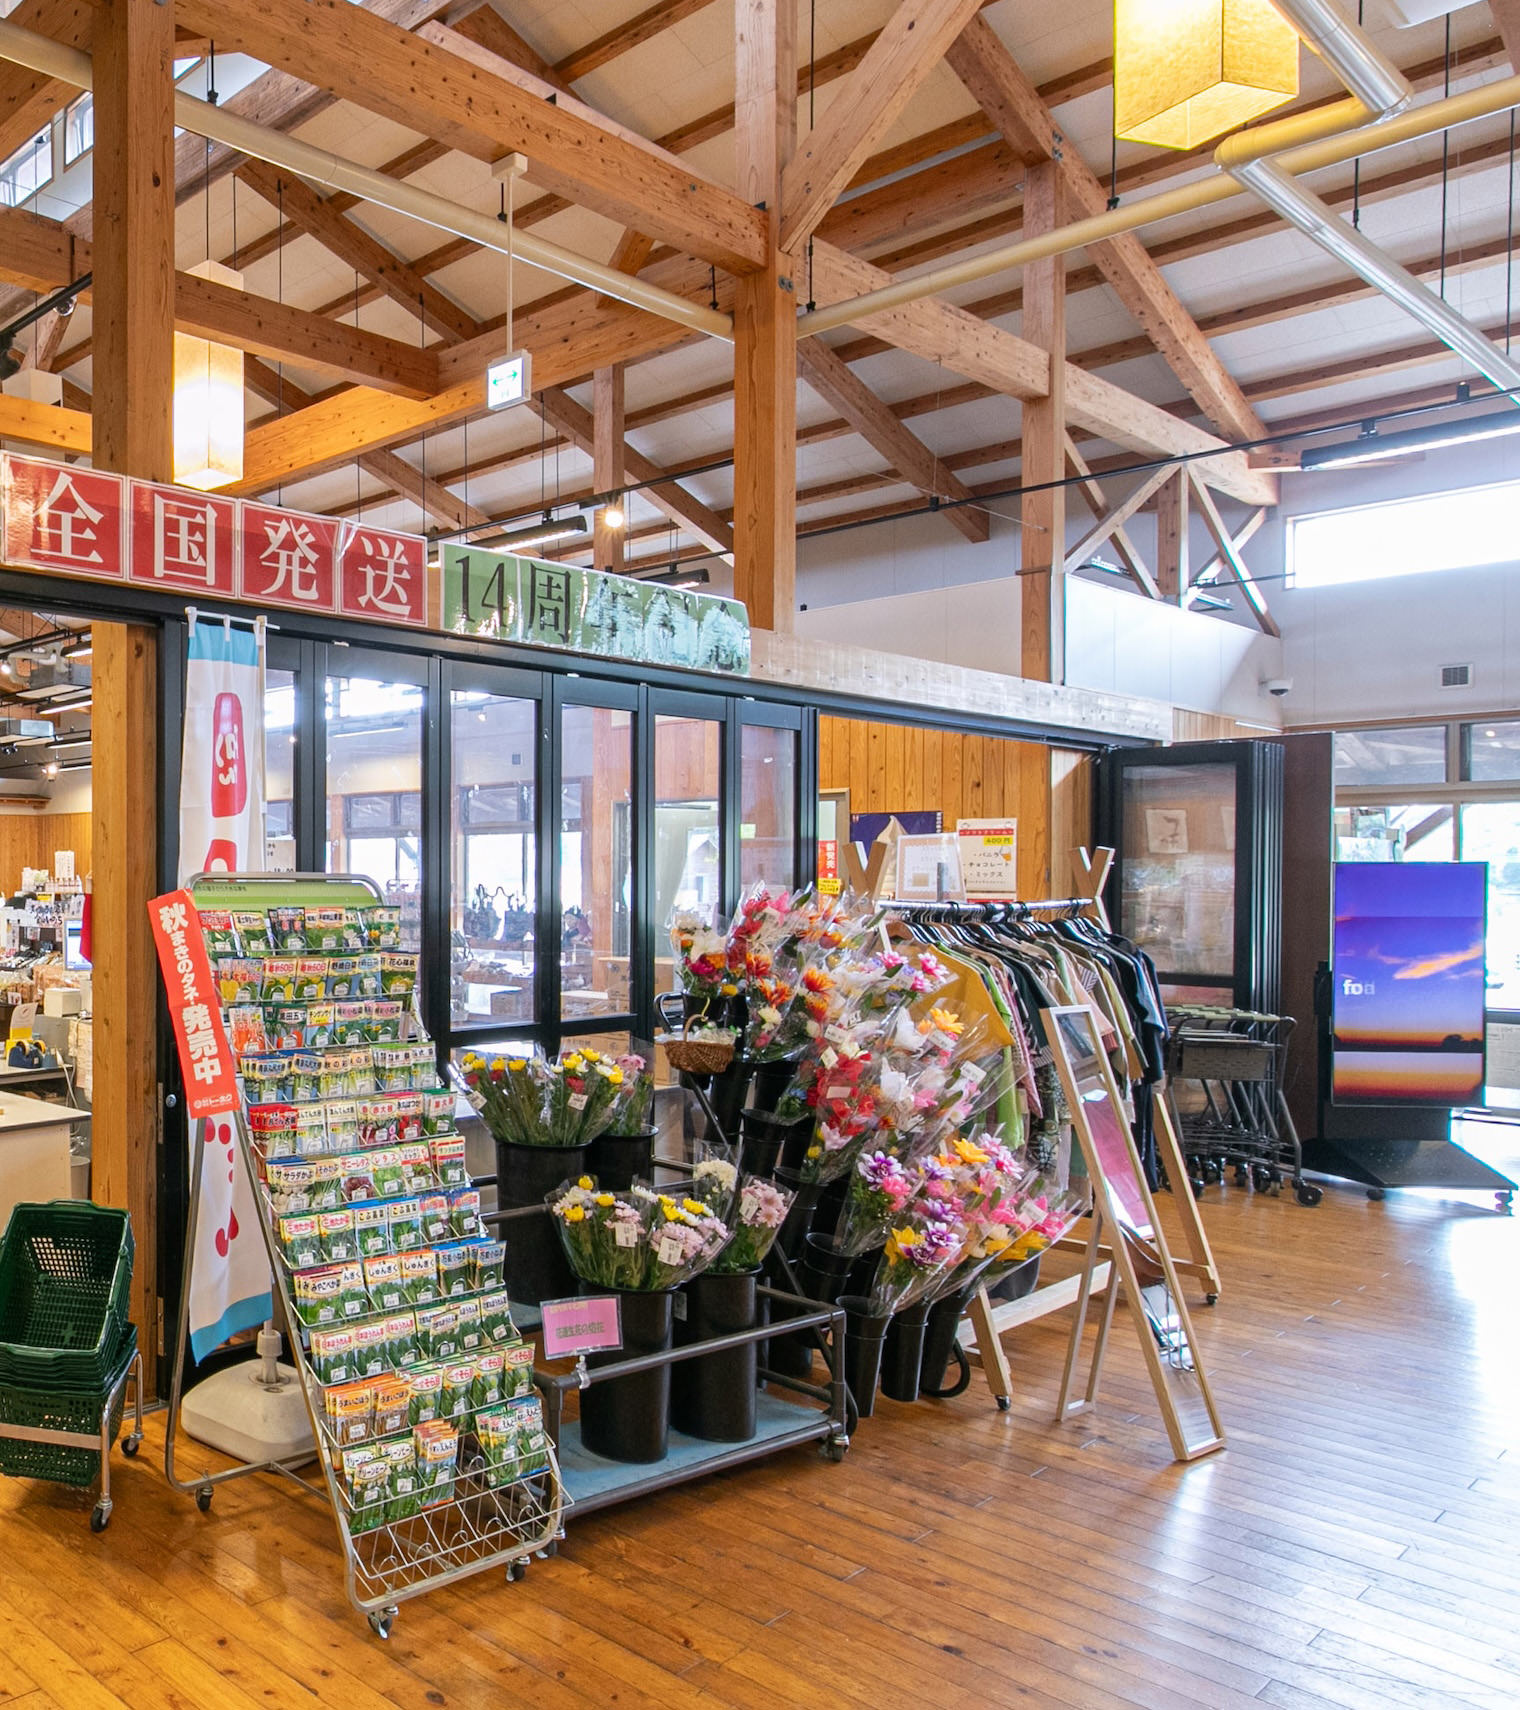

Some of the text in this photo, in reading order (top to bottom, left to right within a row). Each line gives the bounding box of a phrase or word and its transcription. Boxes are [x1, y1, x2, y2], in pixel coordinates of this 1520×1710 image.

[158, 902, 222, 1086] 秋まきのタネ発売中
